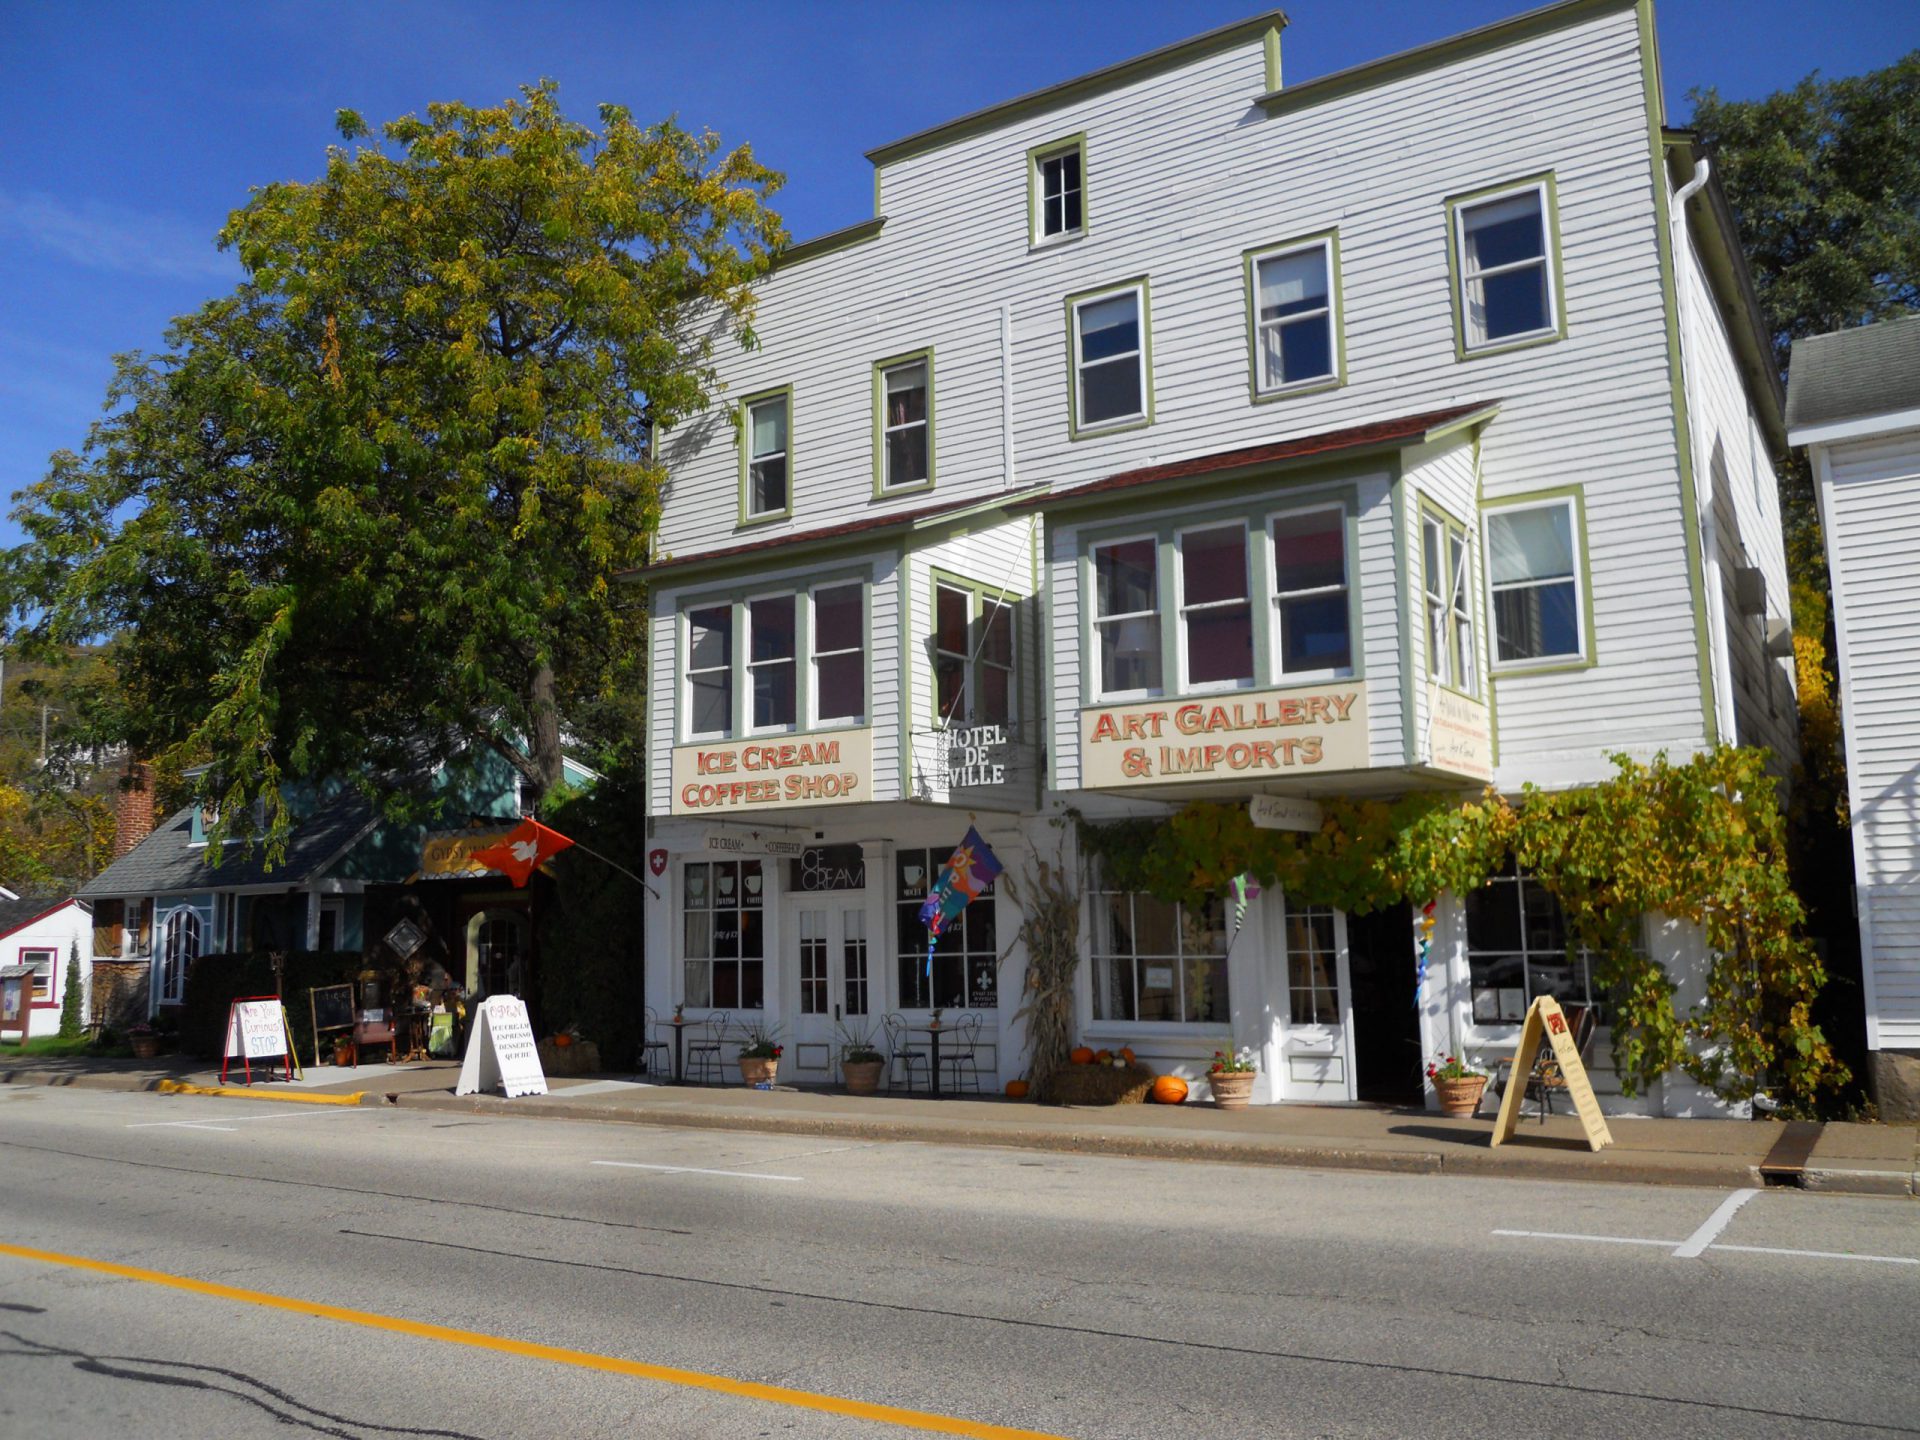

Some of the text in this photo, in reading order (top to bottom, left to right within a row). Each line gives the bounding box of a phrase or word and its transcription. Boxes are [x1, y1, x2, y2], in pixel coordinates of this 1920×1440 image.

[1090, 693, 1357, 743] ART GALLERY
[946, 725, 1006, 748] HOTEL
[697, 741, 840, 775] ICE CREAM
[965, 746, 989, 767] DE
[1121, 736, 1323, 778] & IMPORTS
[949, 764, 1005, 787] VILLE
[682, 772, 858, 807] COFFEE SHOP
[432, 846, 464, 861] GYPSY
[709, 837, 741, 850] ICE CREAM
[801, 849, 824, 871] ICE
[802, 866, 864, 890] CREAM
[252, 1036, 278, 1055] STOP
